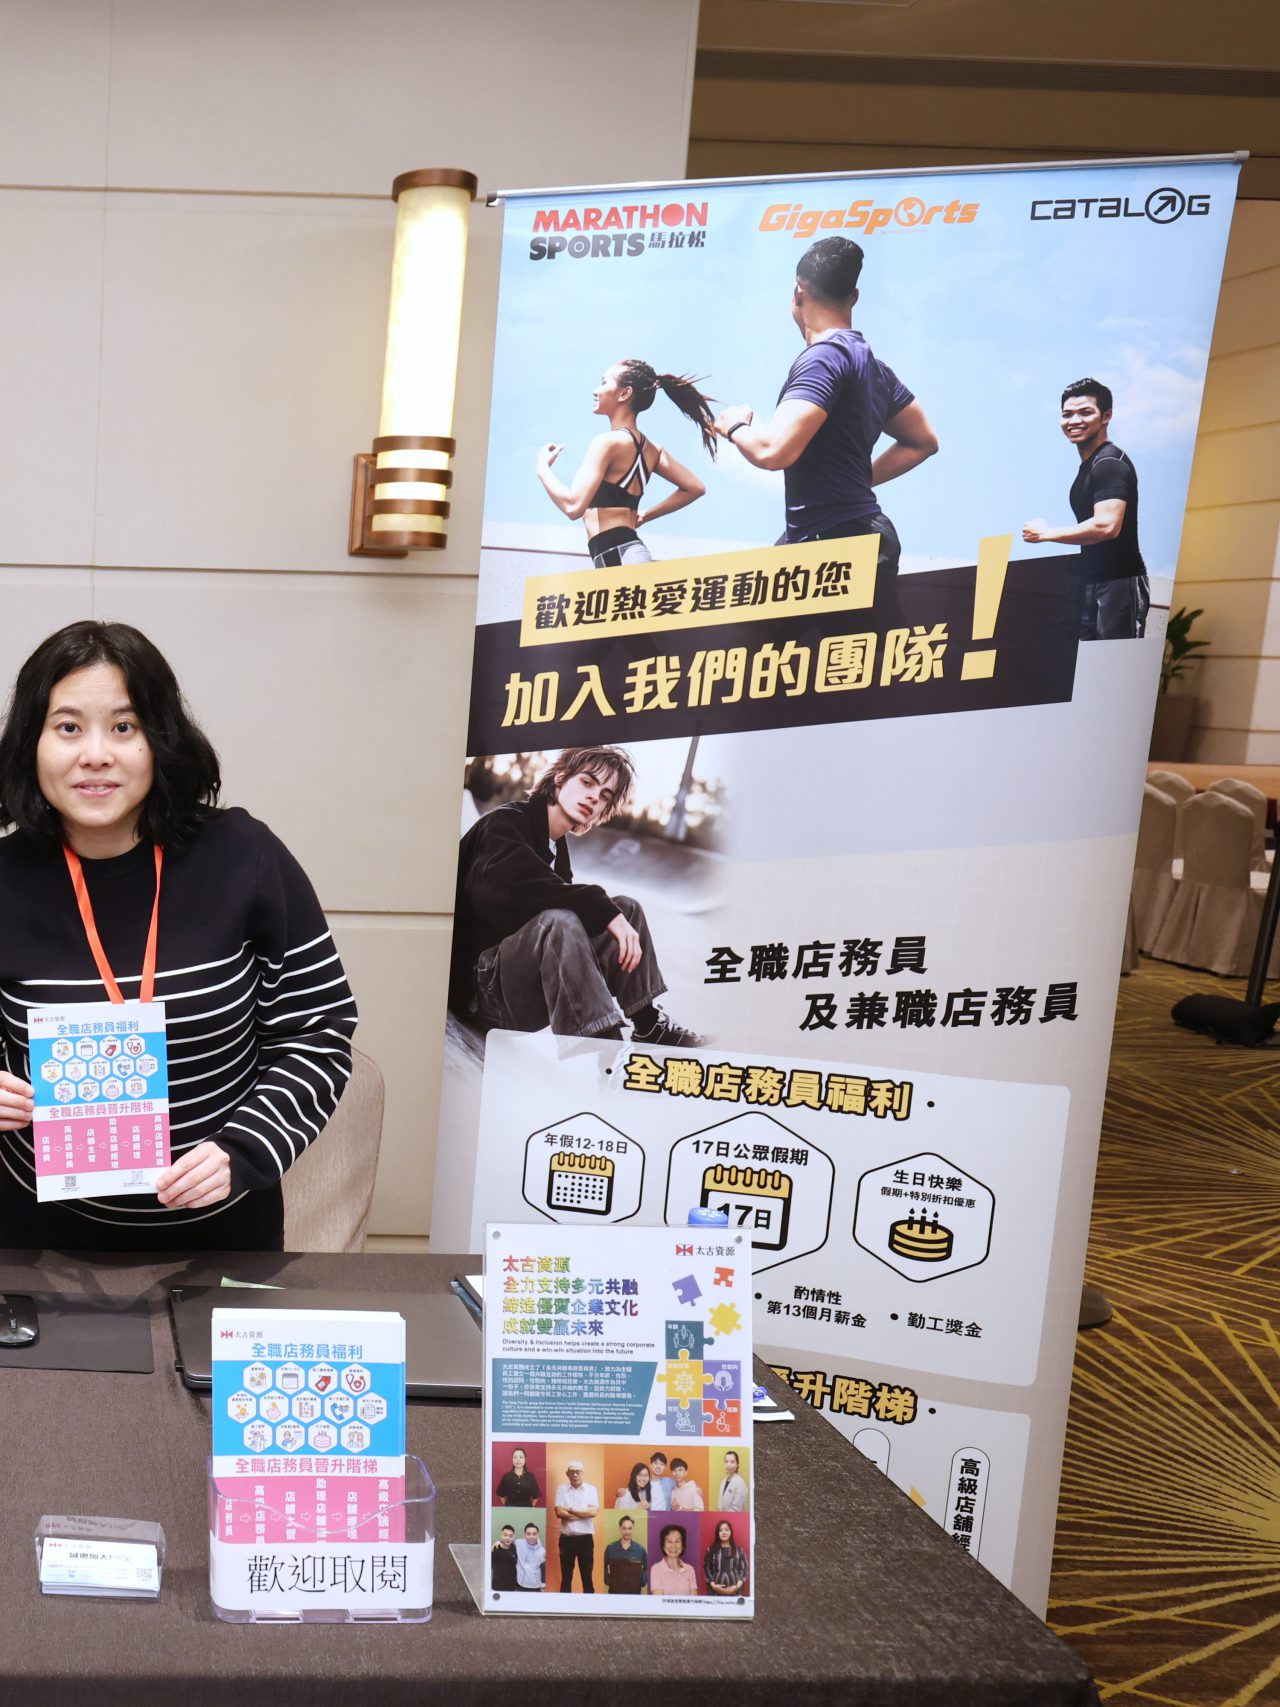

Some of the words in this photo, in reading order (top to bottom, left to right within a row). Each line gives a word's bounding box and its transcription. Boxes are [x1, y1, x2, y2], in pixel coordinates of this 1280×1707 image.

[532, 202, 709, 233] MARATHON
[758, 196, 980, 238] GigaSports
[1030, 187, 1211, 224] CATALOG
[529, 233, 646, 261] SPORTS
[648, 231, 707, 249] 馬拉松
[534, 560, 853, 630] 歡迎熱愛運動的您
[703, 936, 929, 985] 全職店務員
[798, 982, 1080, 1033] 及兼職店務員
[624, 1054, 914, 1121] 全職店務員福利
[544, 1132, 628, 1156] 年假12-18日
[691, 1139, 809, 1166] 17日公眾假期
[893, 1170, 963, 1191] 生日快樂
[880, 1186, 977, 1209] 假期+特別折扣優惠
[503, 1255, 570, 1273] 太古資源
[695, 1245, 736, 1257] 太古資源
[503, 1276, 639, 1296] 全力支持多元共融
[793, 1284, 843, 1305] 酌情性
[502, 1296, 639, 1317] 締造優質企業文化
[767, 1299, 867, 1329] 第13個月薪金
[502, 1317, 604, 1336] 成就雙贏未來
[907, 1312, 983, 1339] 勤工獎金
[251, 1343, 363, 1360] 全職店務員福利
[235, 1458, 378, 1474] 全職店務員晉升階梯
[246, 1554, 408, 1594] 歡迎取閱
